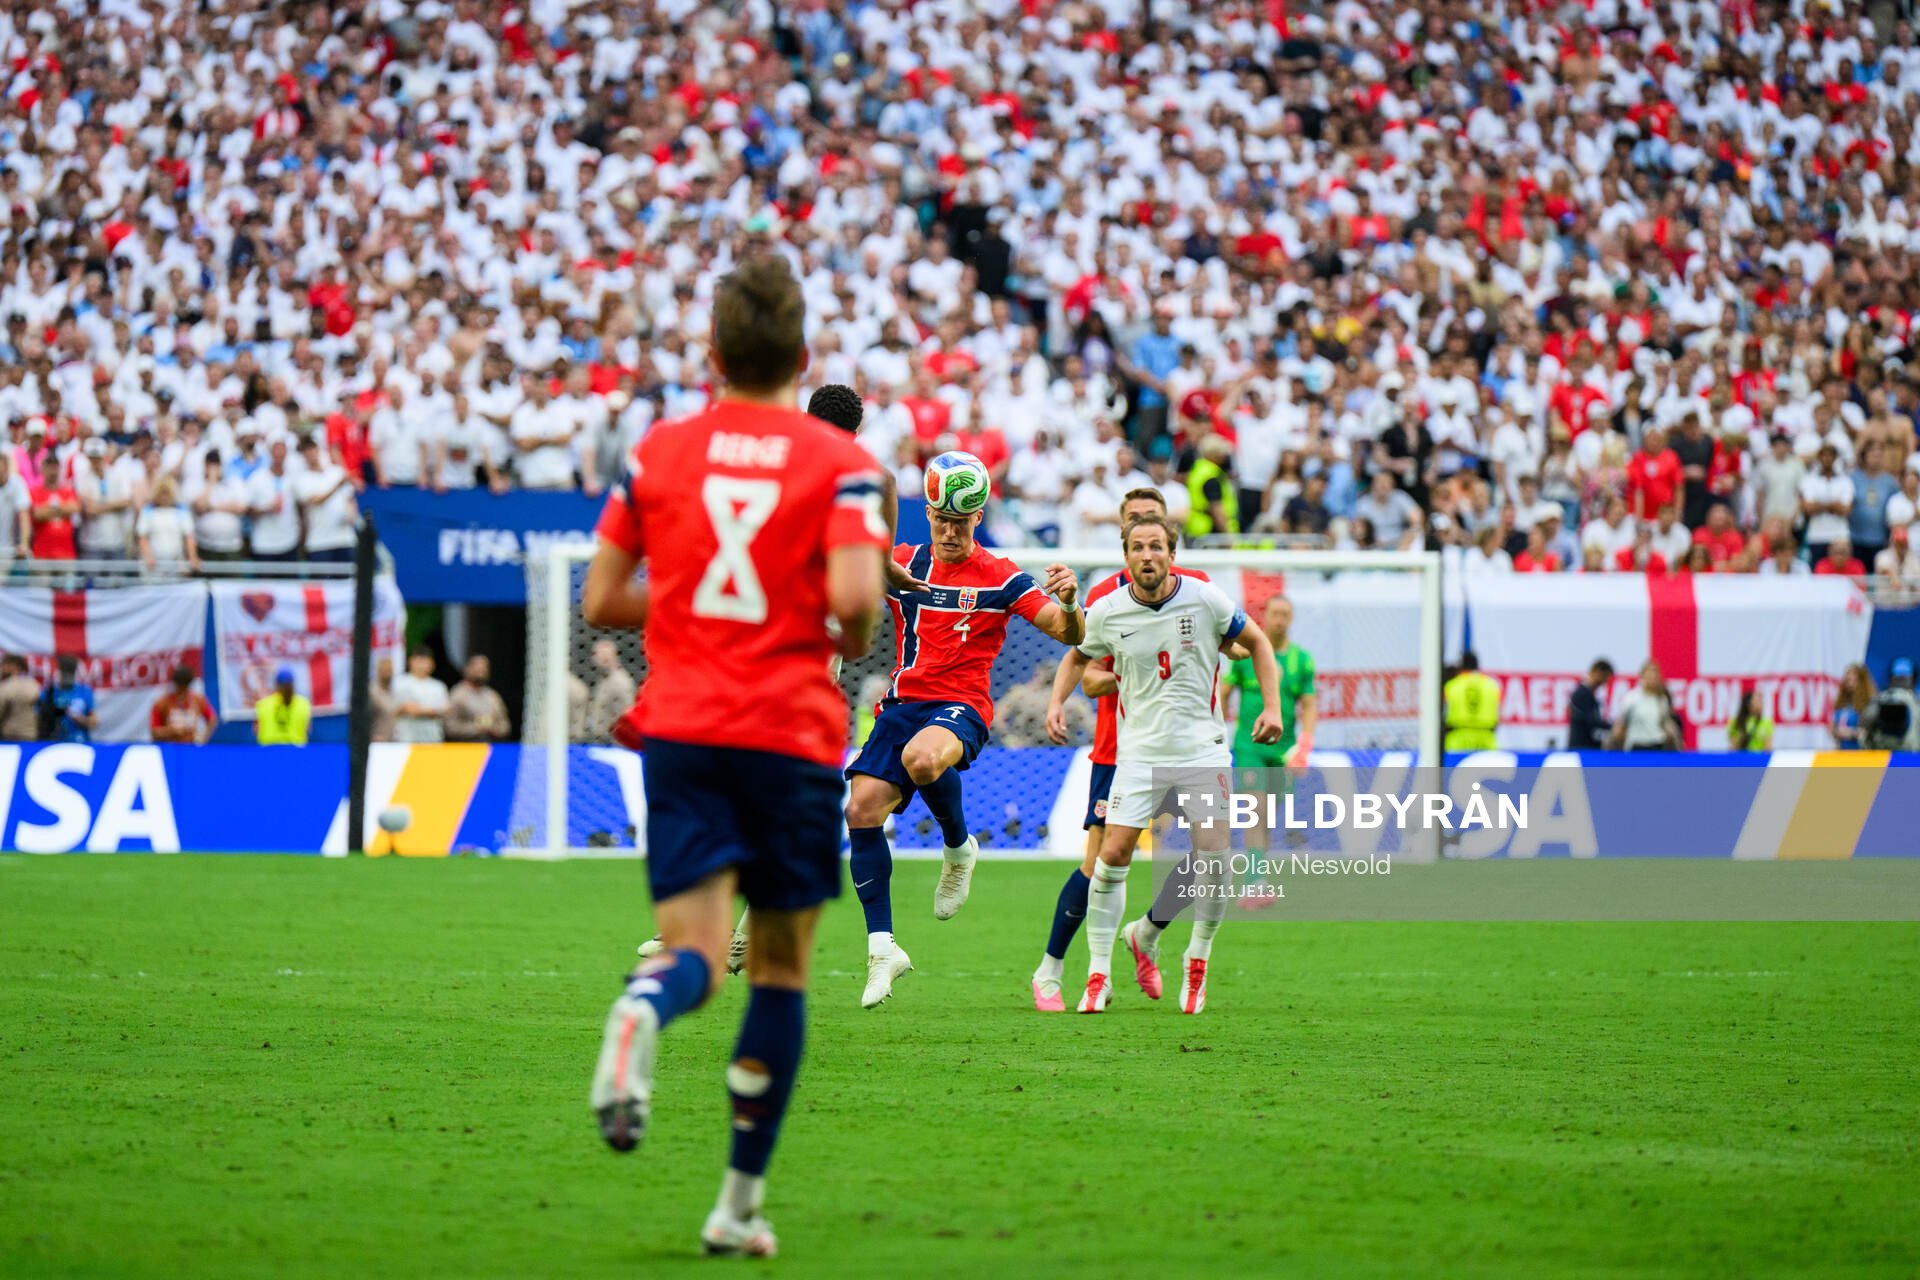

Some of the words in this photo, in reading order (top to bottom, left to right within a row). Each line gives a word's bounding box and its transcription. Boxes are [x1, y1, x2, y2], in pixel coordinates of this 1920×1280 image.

[438, 528, 520, 566] FIFA
[692, 474, 781, 625] 8
[953, 614, 971, 642] 4
[1158, 651, 1172, 680] 9
[1217, 773, 1230, 800] 9
